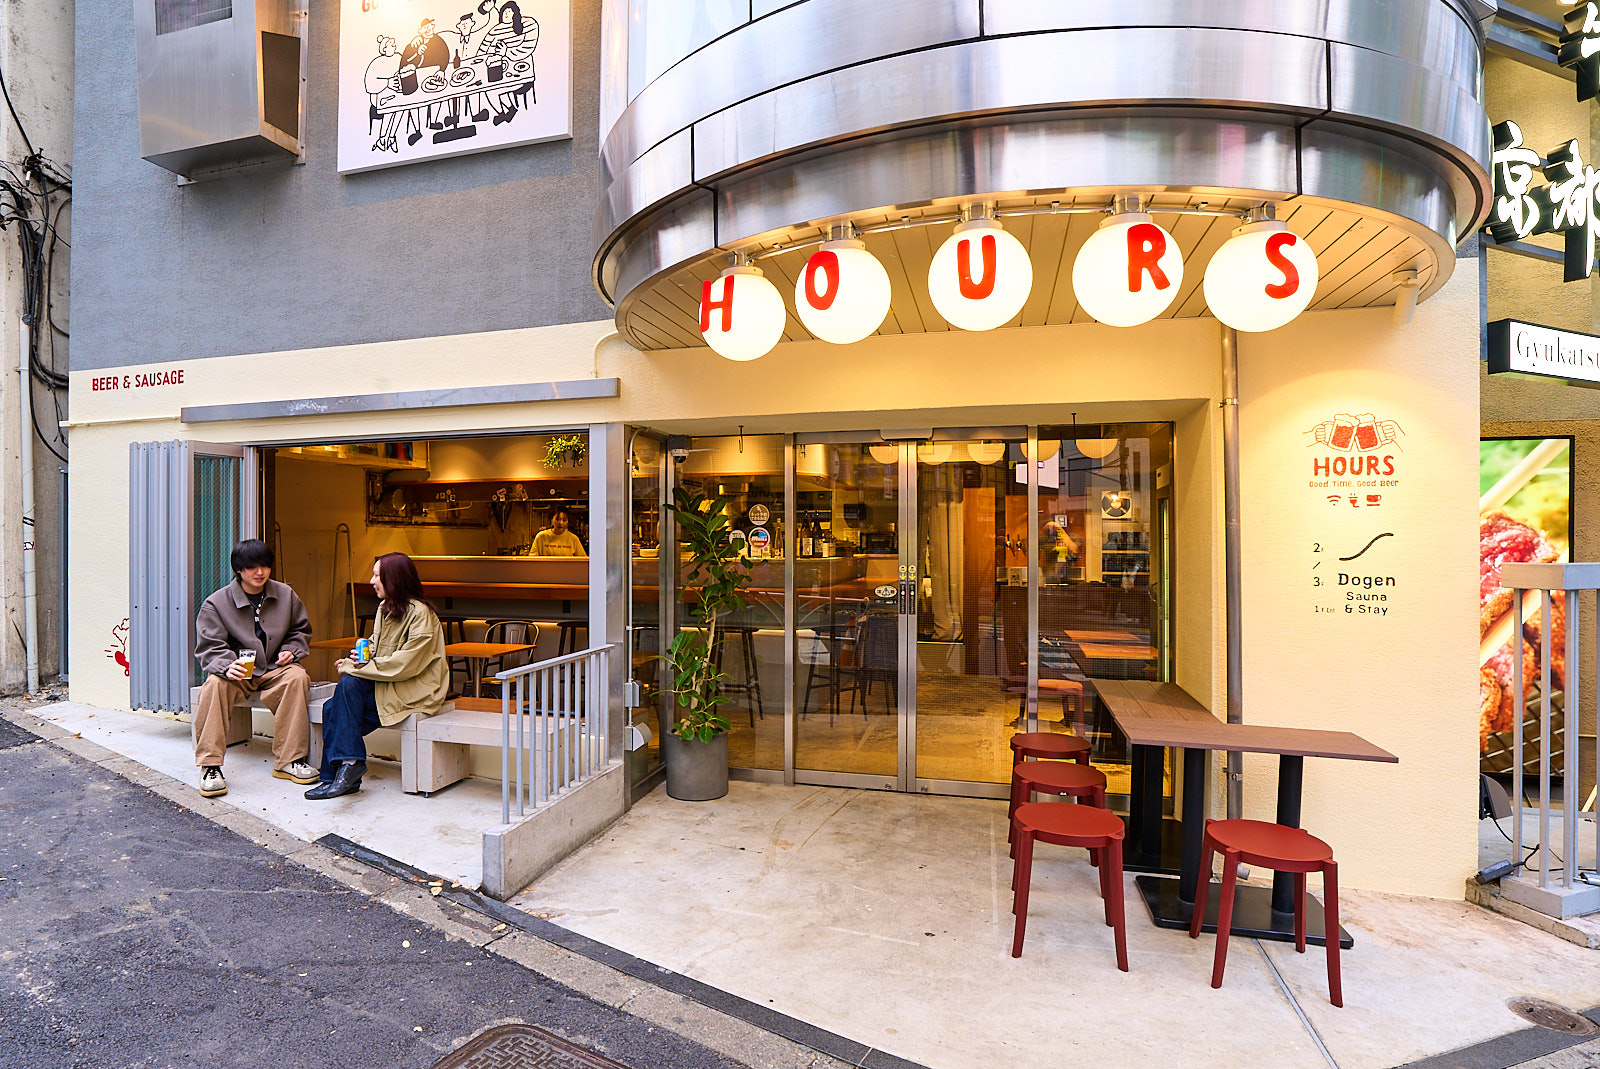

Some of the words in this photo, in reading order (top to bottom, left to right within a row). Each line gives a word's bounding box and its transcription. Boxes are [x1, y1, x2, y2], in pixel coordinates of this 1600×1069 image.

[92, 376, 119, 392] BEER
[123, 375, 131, 389] &
[135, 369, 185, 388] SAUSAGE
[1313, 455, 1395, 477] HOURS
[1308, 480, 1329, 488] Good
[1356, 479, 1377, 487] Good
[1380, 479, 1399, 487] Beer
[1337, 572, 1396, 590] Dogen
[1346, 591, 1387, 602] Sauna
[1345, 604, 1353, 614] &
[1358, 604, 1389, 616] Stay
